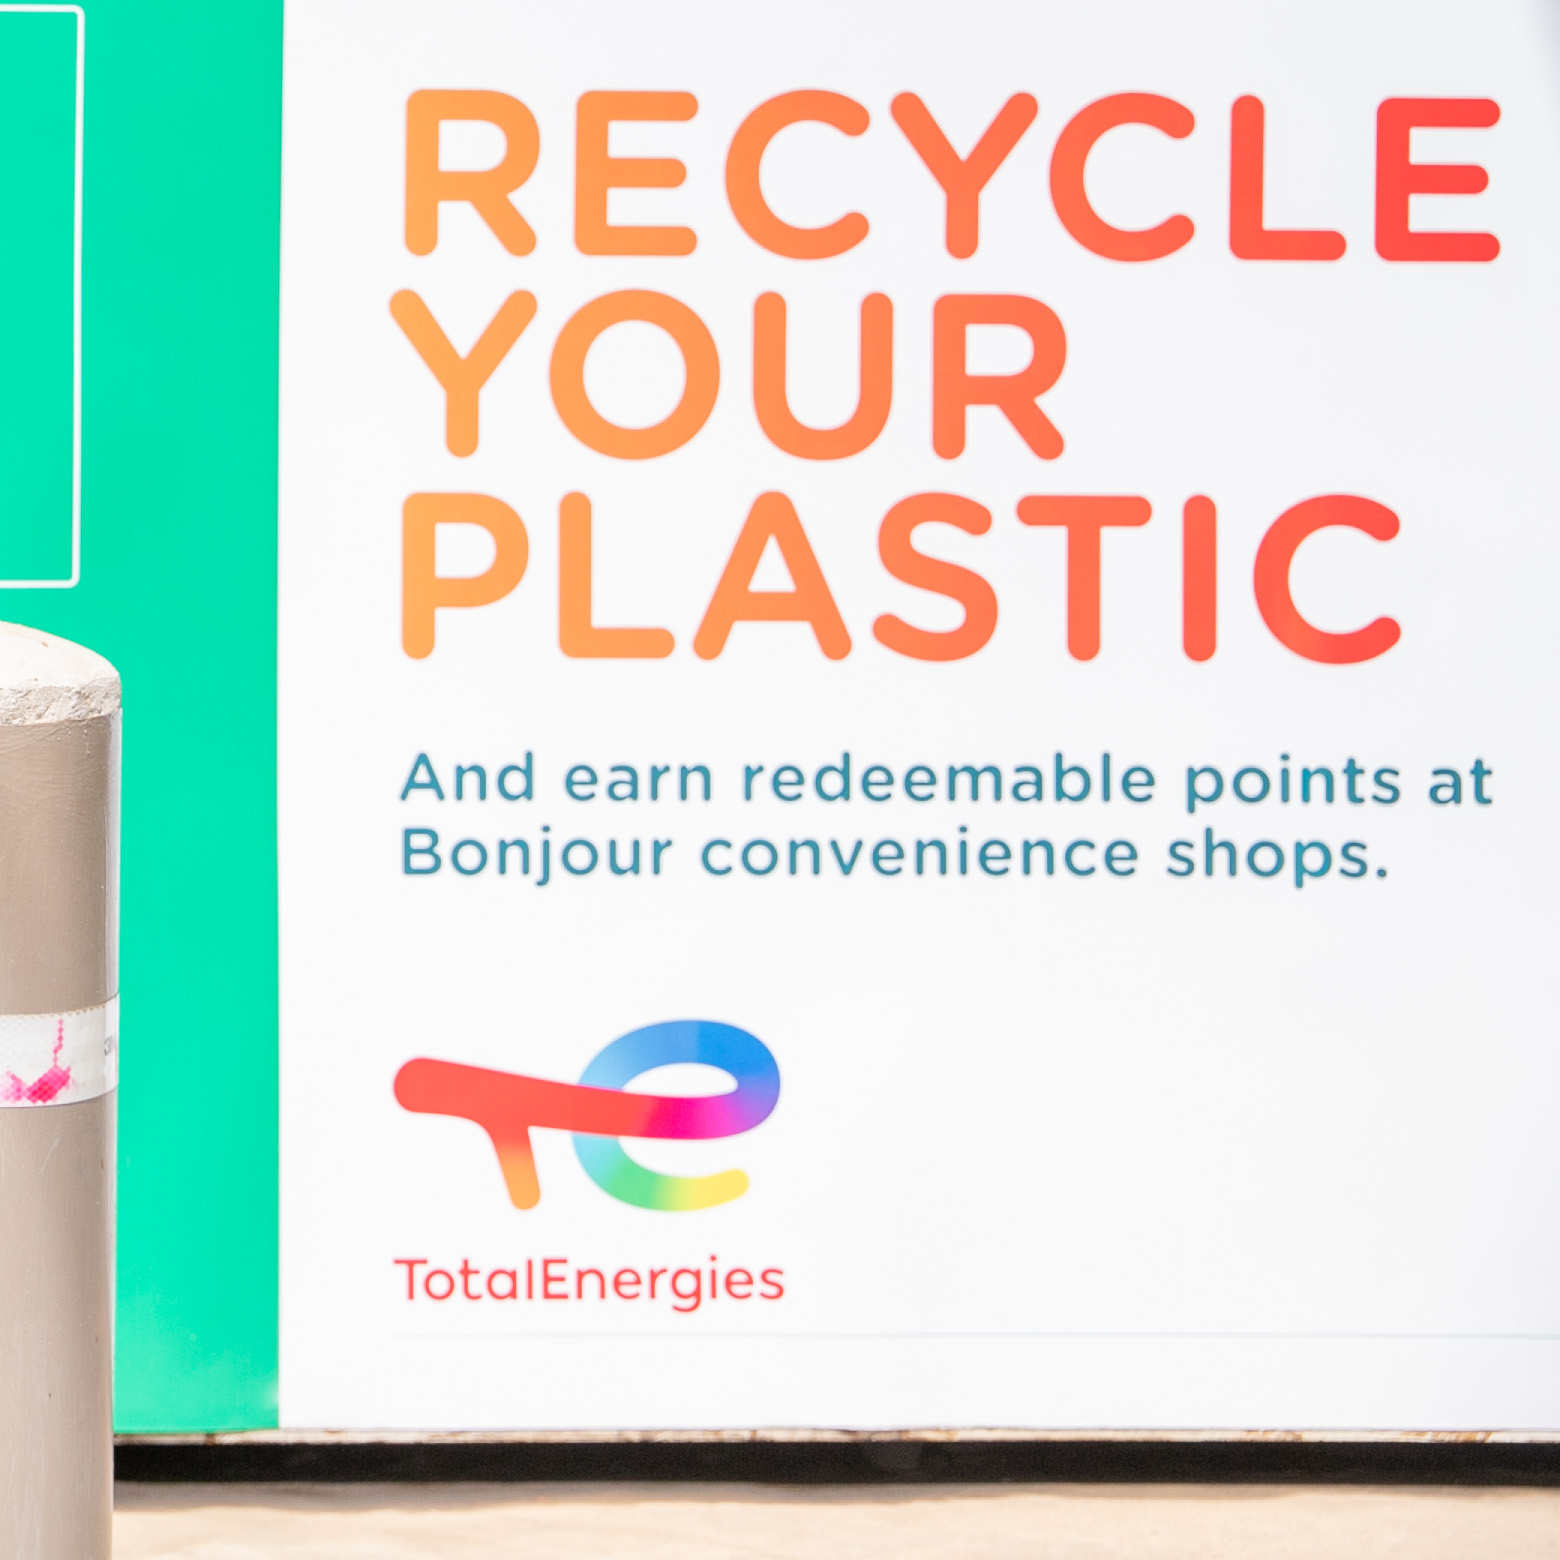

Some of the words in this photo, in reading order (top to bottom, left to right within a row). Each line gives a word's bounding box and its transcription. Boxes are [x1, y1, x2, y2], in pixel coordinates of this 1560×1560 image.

[403, 88, 1502, 263] RECYCLE
[388, 288, 1068, 461] YOUR
[401, 491, 1402, 665] PLASTIC
[400, 751, 534, 802] And
[564, 765, 713, 802] earn
[743, 752, 1156, 804] redeemable
[1185, 753, 1402, 815] points
[1428, 758, 1494, 806] at
[402, 825, 673, 886] Bonjour
[700, 825, 1139, 878] convenience
[1166, 827, 1388, 888] shops.
[393, 1254, 785, 1313] TotalEnergies
